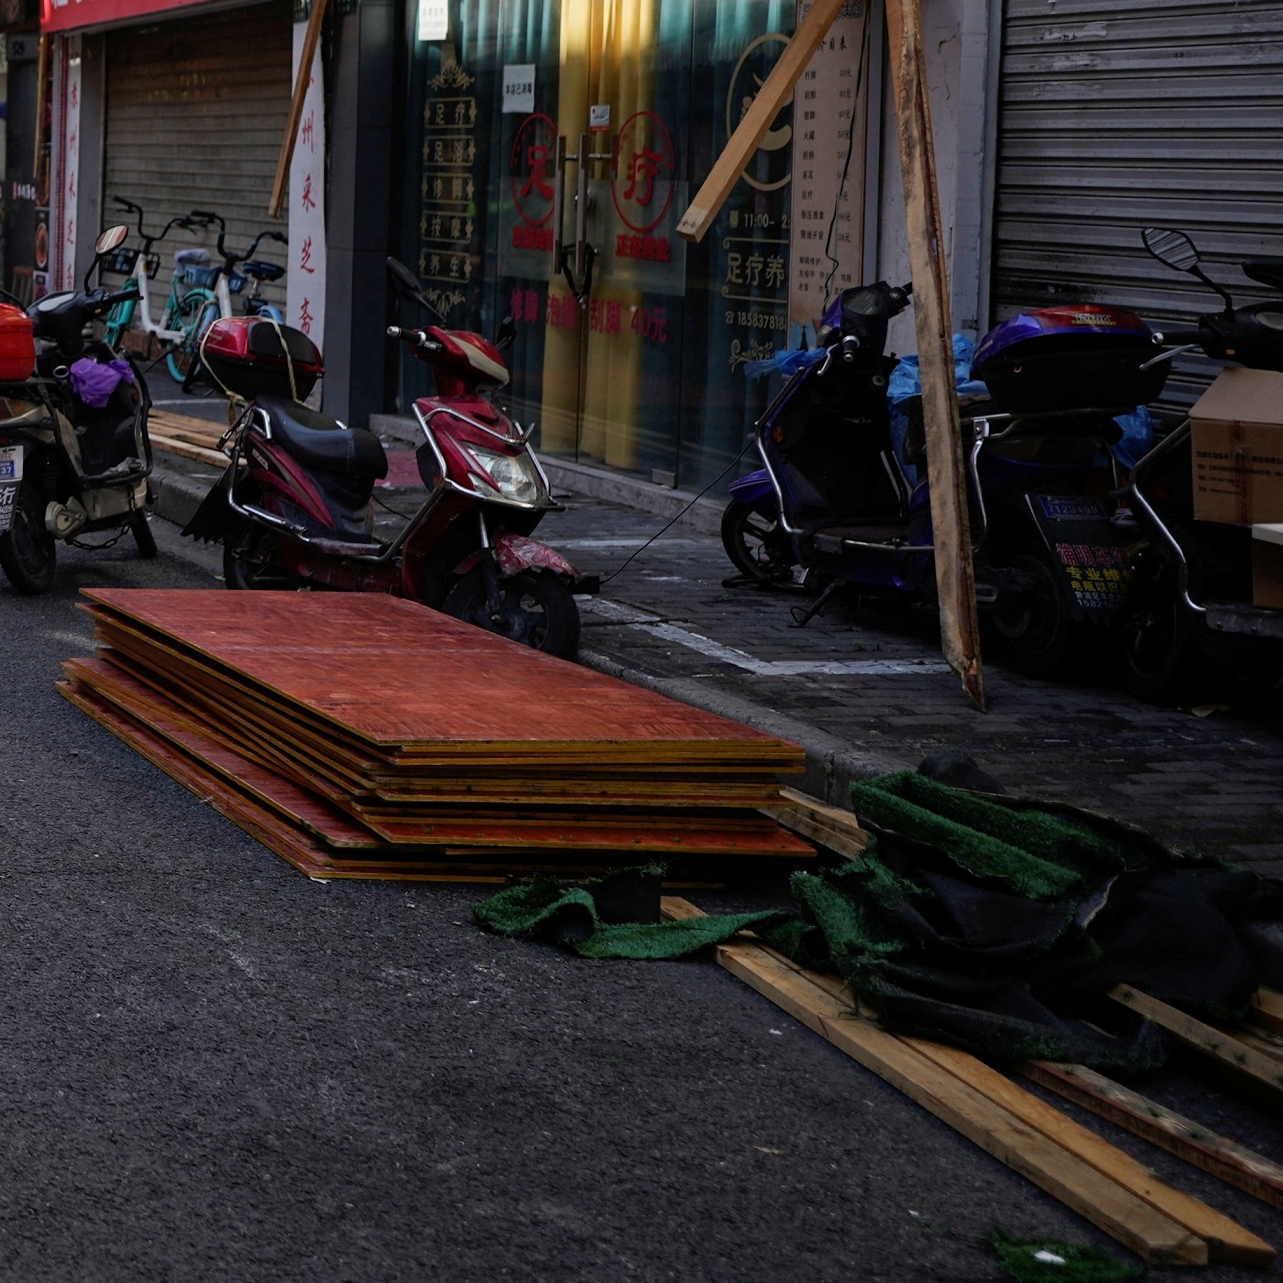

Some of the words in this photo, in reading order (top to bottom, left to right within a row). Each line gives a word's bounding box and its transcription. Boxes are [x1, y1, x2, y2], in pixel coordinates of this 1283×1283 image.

[435, 101, 466, 125] 足疗
[520, 144, 554, 201] 足
[623, 144, 663, 208] 疗
[725, 252, 785, 288] 足疗养
[737, 310, 787, 330] 185837818
